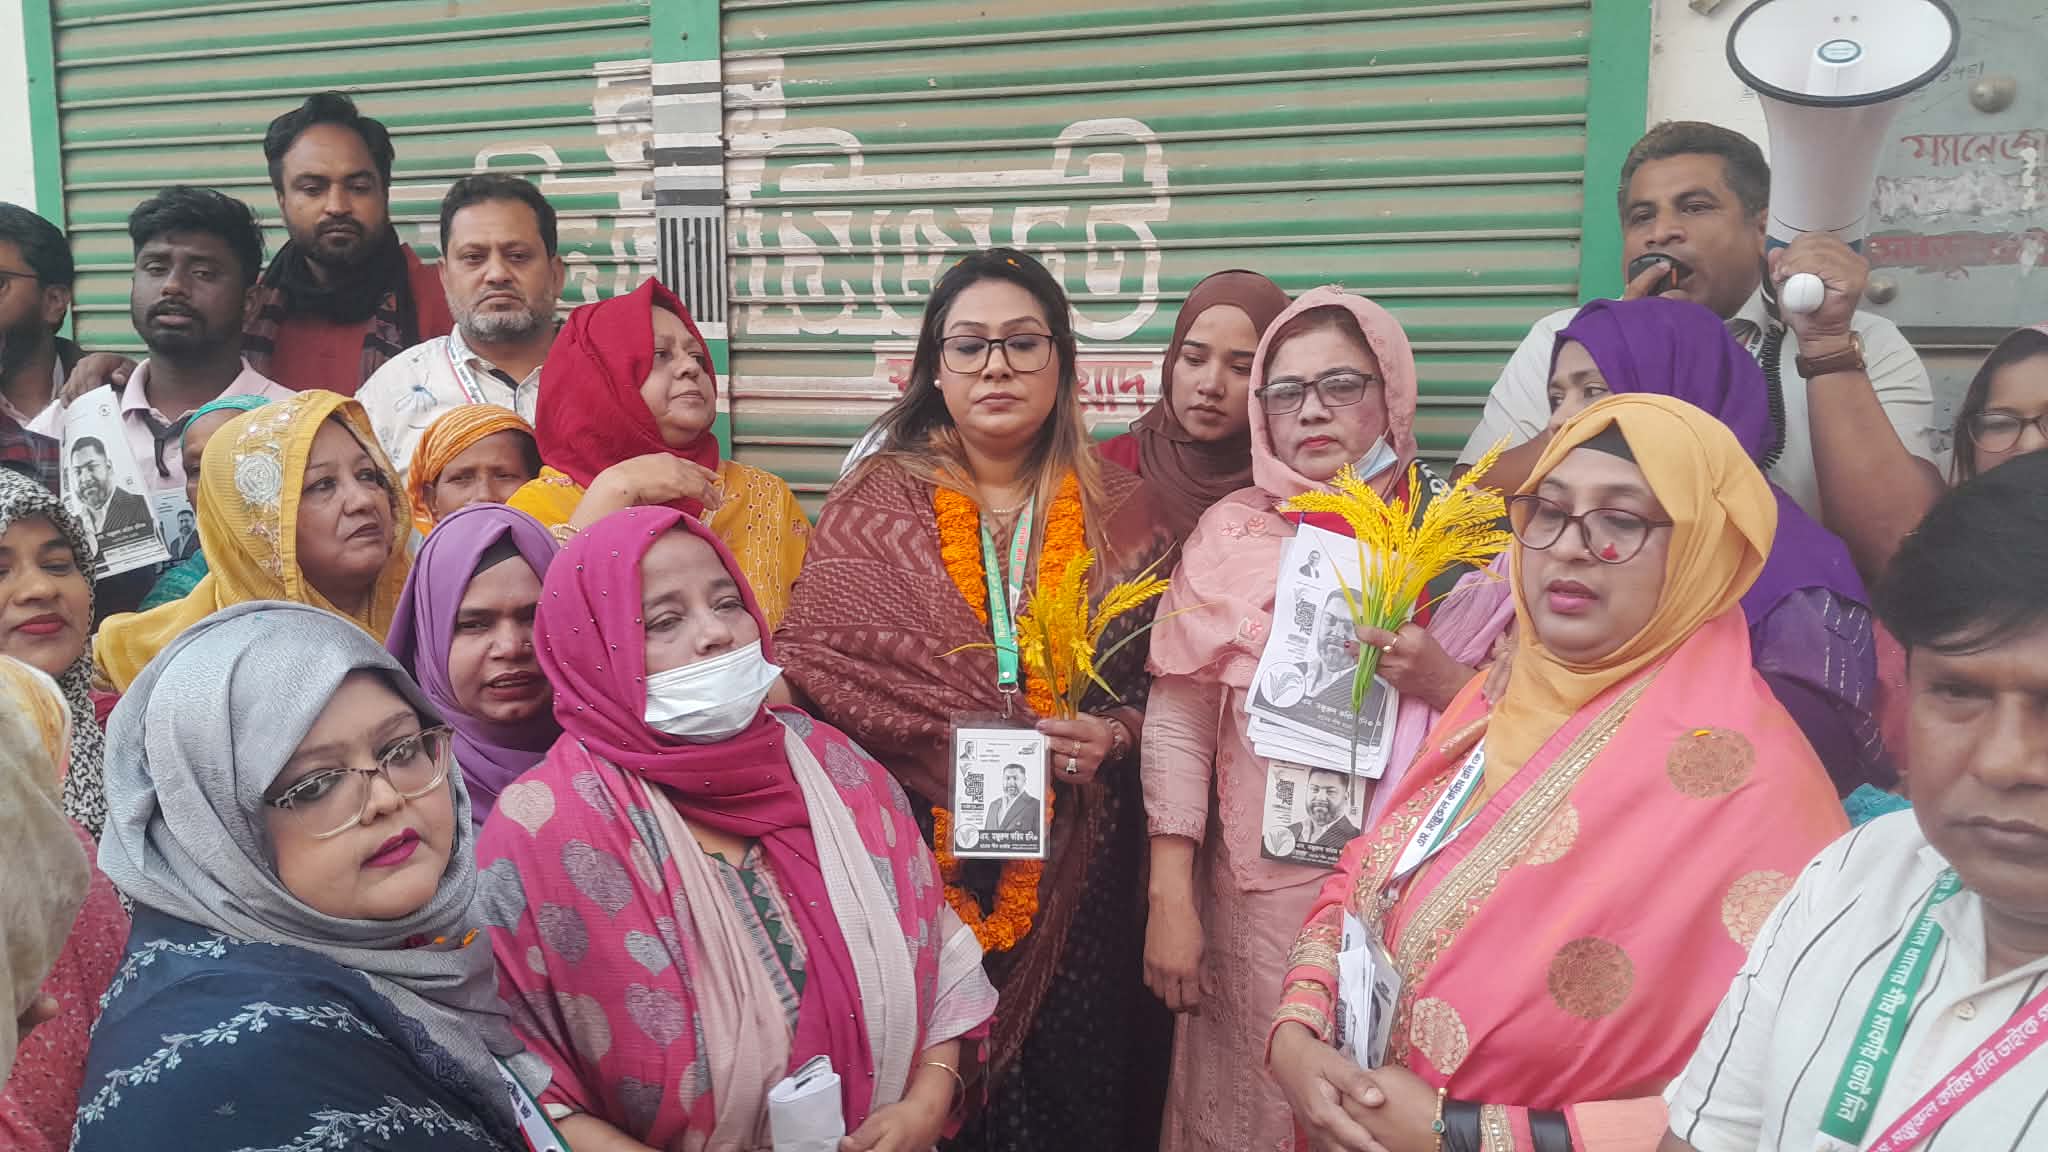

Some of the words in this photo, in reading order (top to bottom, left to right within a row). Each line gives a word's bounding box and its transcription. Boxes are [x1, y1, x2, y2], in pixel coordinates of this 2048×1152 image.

[1847, 1060, 1876, 1095] ভোট
[1938, 1073, 1976, 1108] করিম
[1971, 1049, 1999, 1080] রনি
[1994, 1015, 2040, 1058] ভাইকে
[1837, 1092, 1869, 1123] দিন
